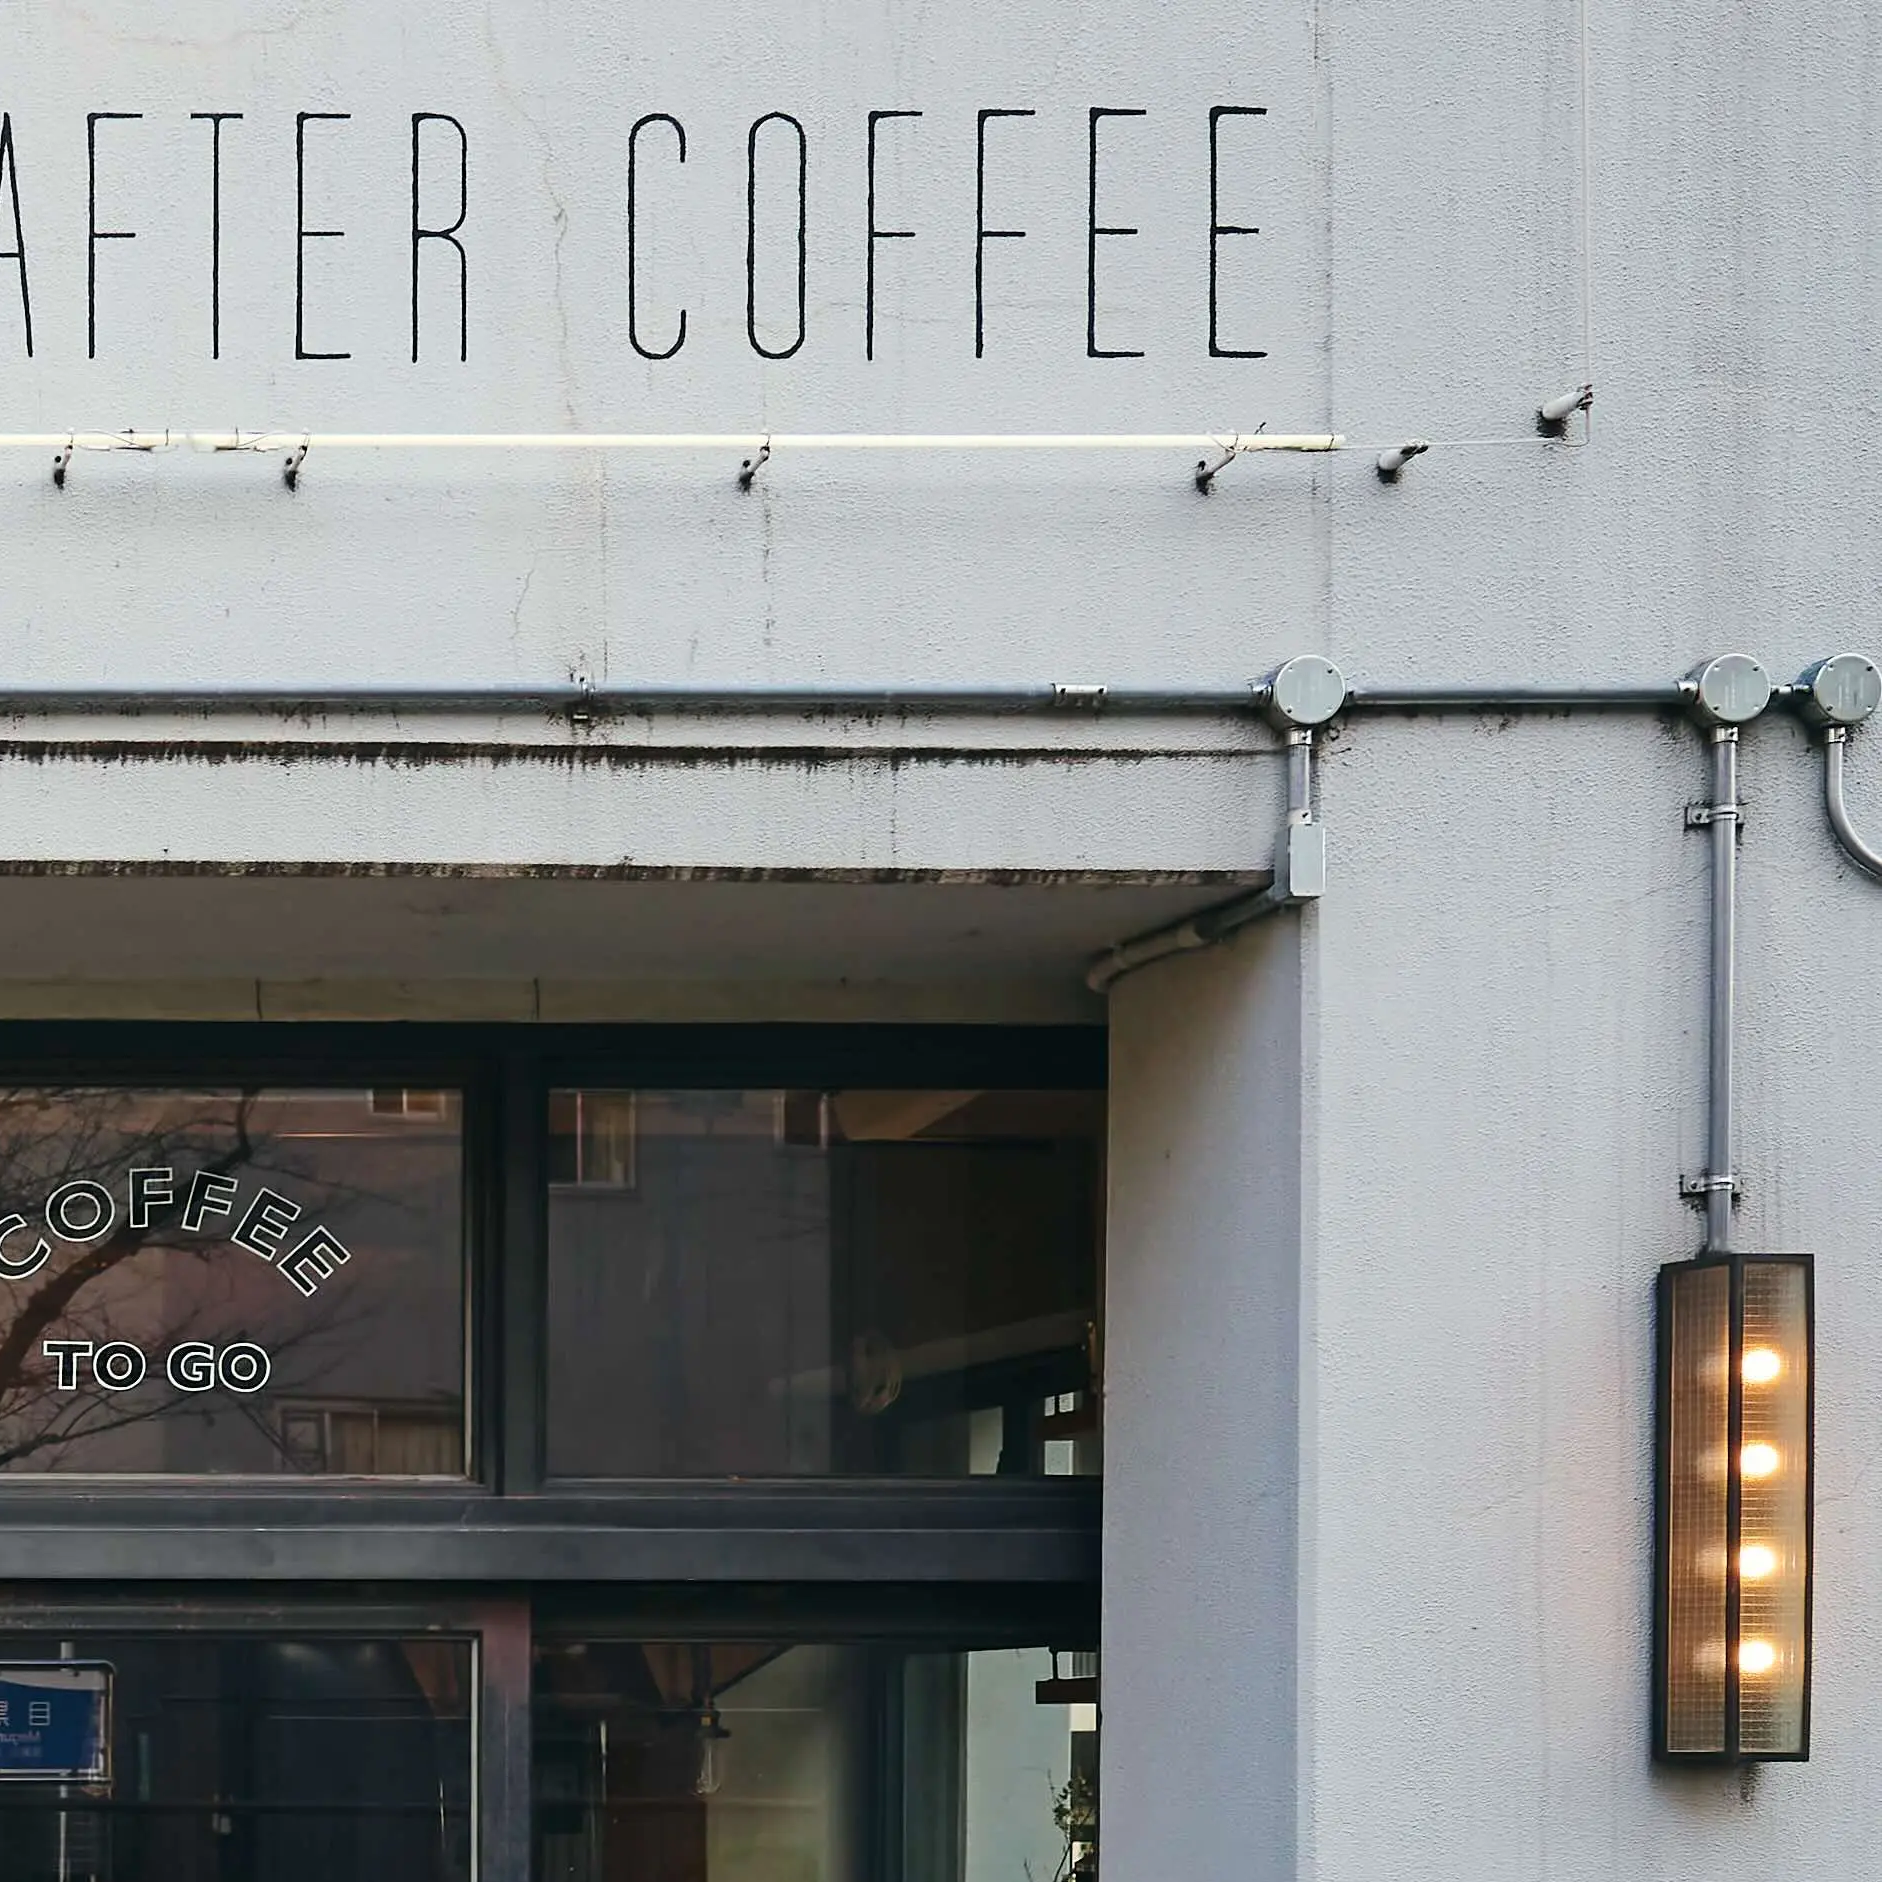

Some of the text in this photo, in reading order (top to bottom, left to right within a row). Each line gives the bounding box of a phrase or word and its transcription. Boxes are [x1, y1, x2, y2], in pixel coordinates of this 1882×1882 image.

[627, 105, 1269, 362] COFFEE
[43, 1340, 271, 1393] TO GO
